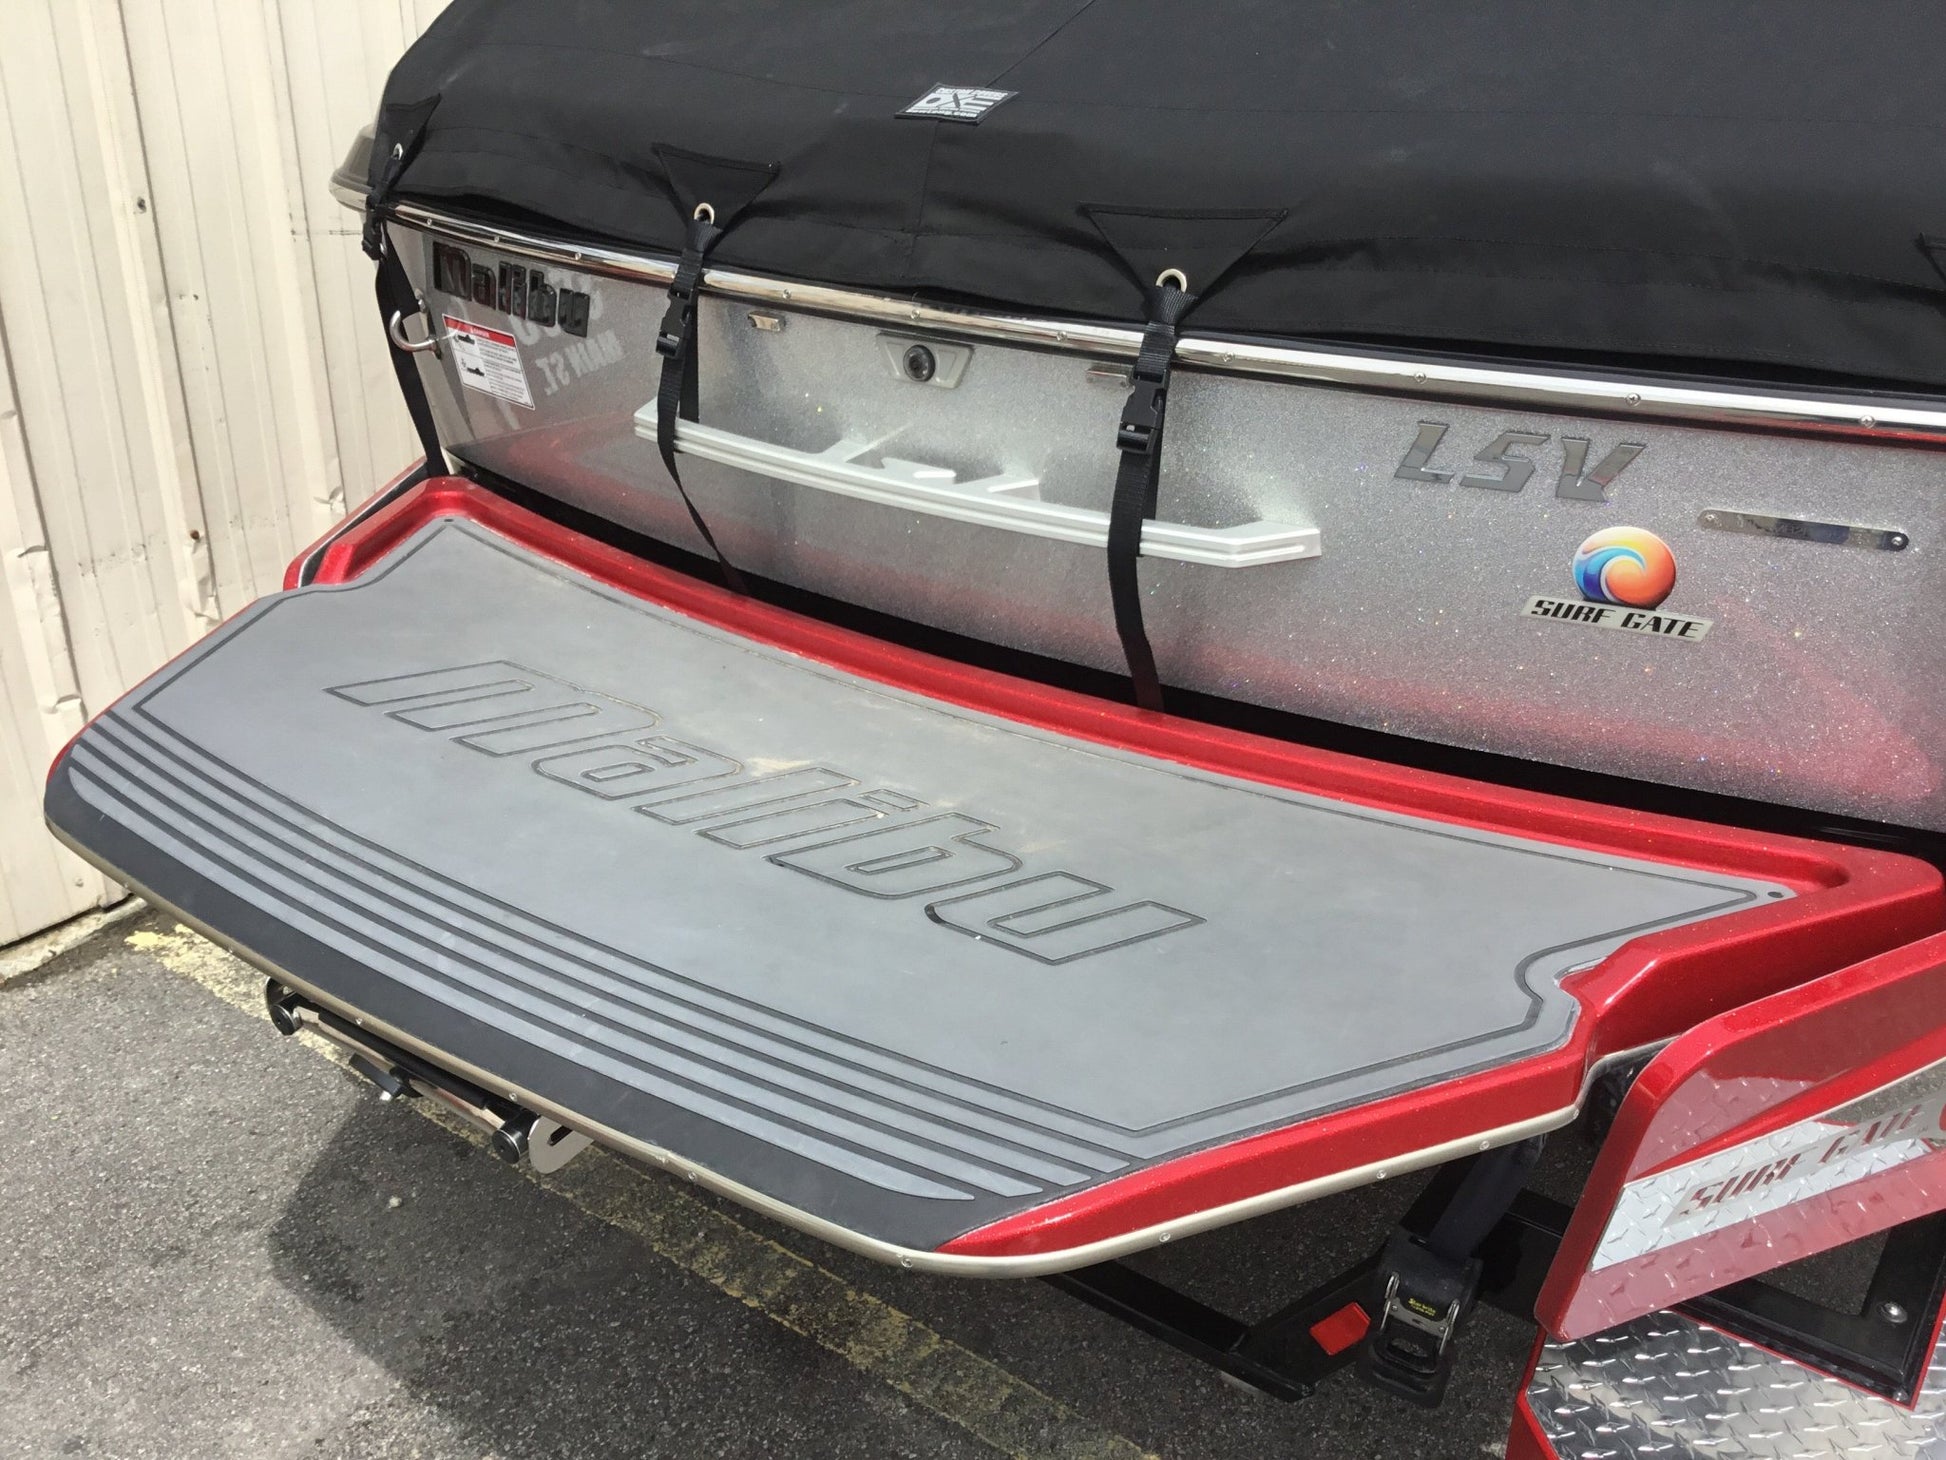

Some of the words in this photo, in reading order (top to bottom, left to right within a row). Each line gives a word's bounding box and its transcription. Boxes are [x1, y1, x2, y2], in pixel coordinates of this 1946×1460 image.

[1394, 420, 1648, 502] LSV
[1530, 599, 1618, 625] SURF
[1620, 609, 1705, 639] GATE
[1679, 1146, 1819, 1216] SURF
